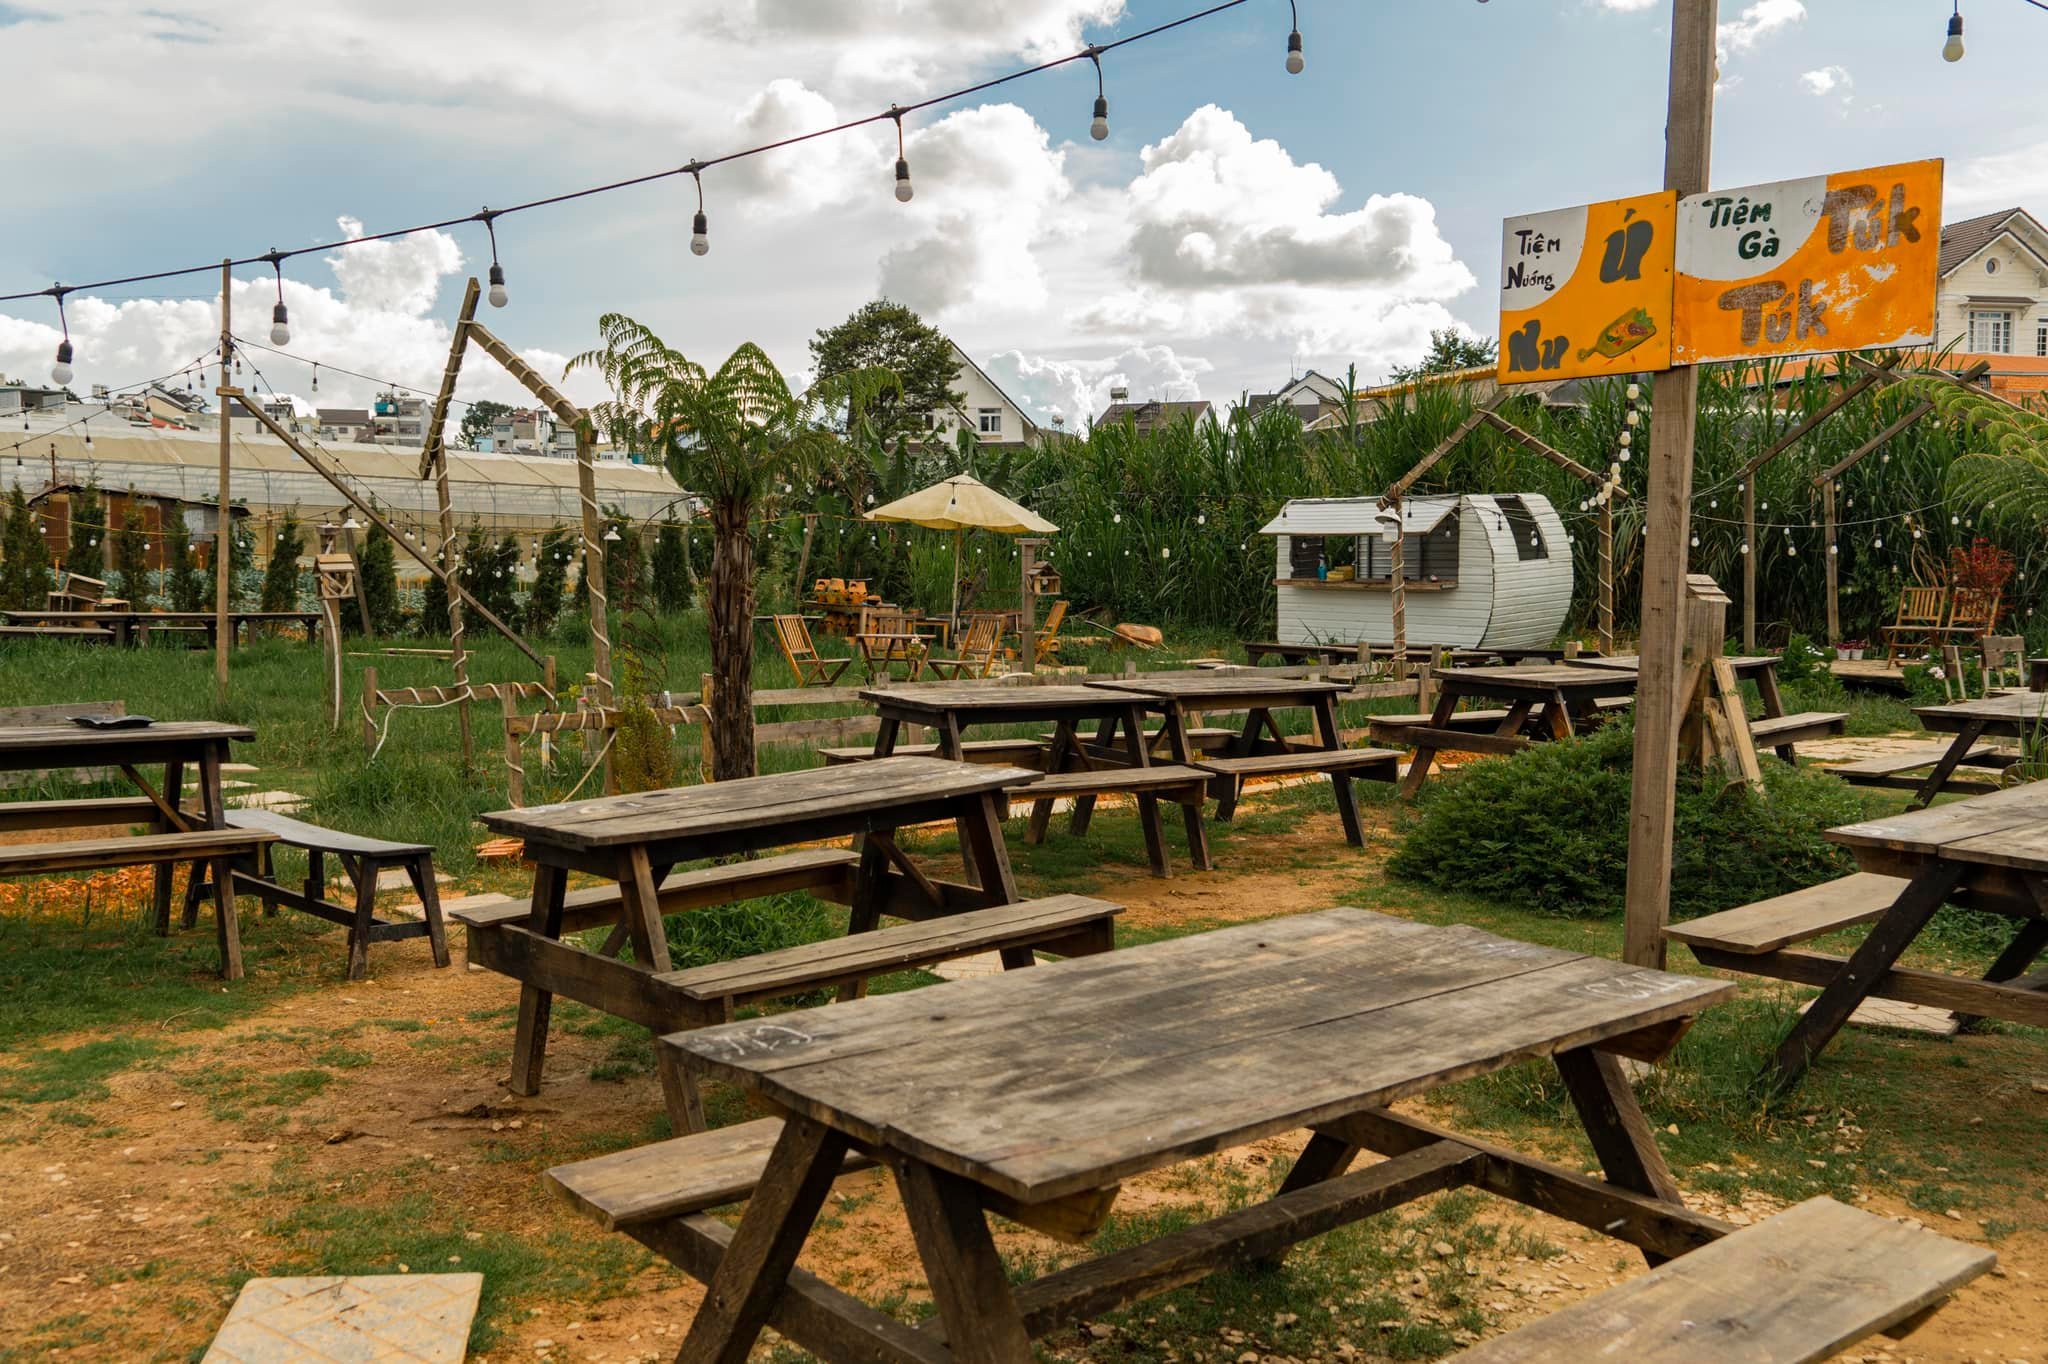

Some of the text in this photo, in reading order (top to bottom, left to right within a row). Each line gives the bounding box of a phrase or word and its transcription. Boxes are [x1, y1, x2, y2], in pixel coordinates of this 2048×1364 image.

[1822, 183, 1920, 254] Túk
[1738, 228, 1779, 259] Gà
[1503, 261, 1555, 291] Nướng
[1718, 279, 1828, 347] Túk
